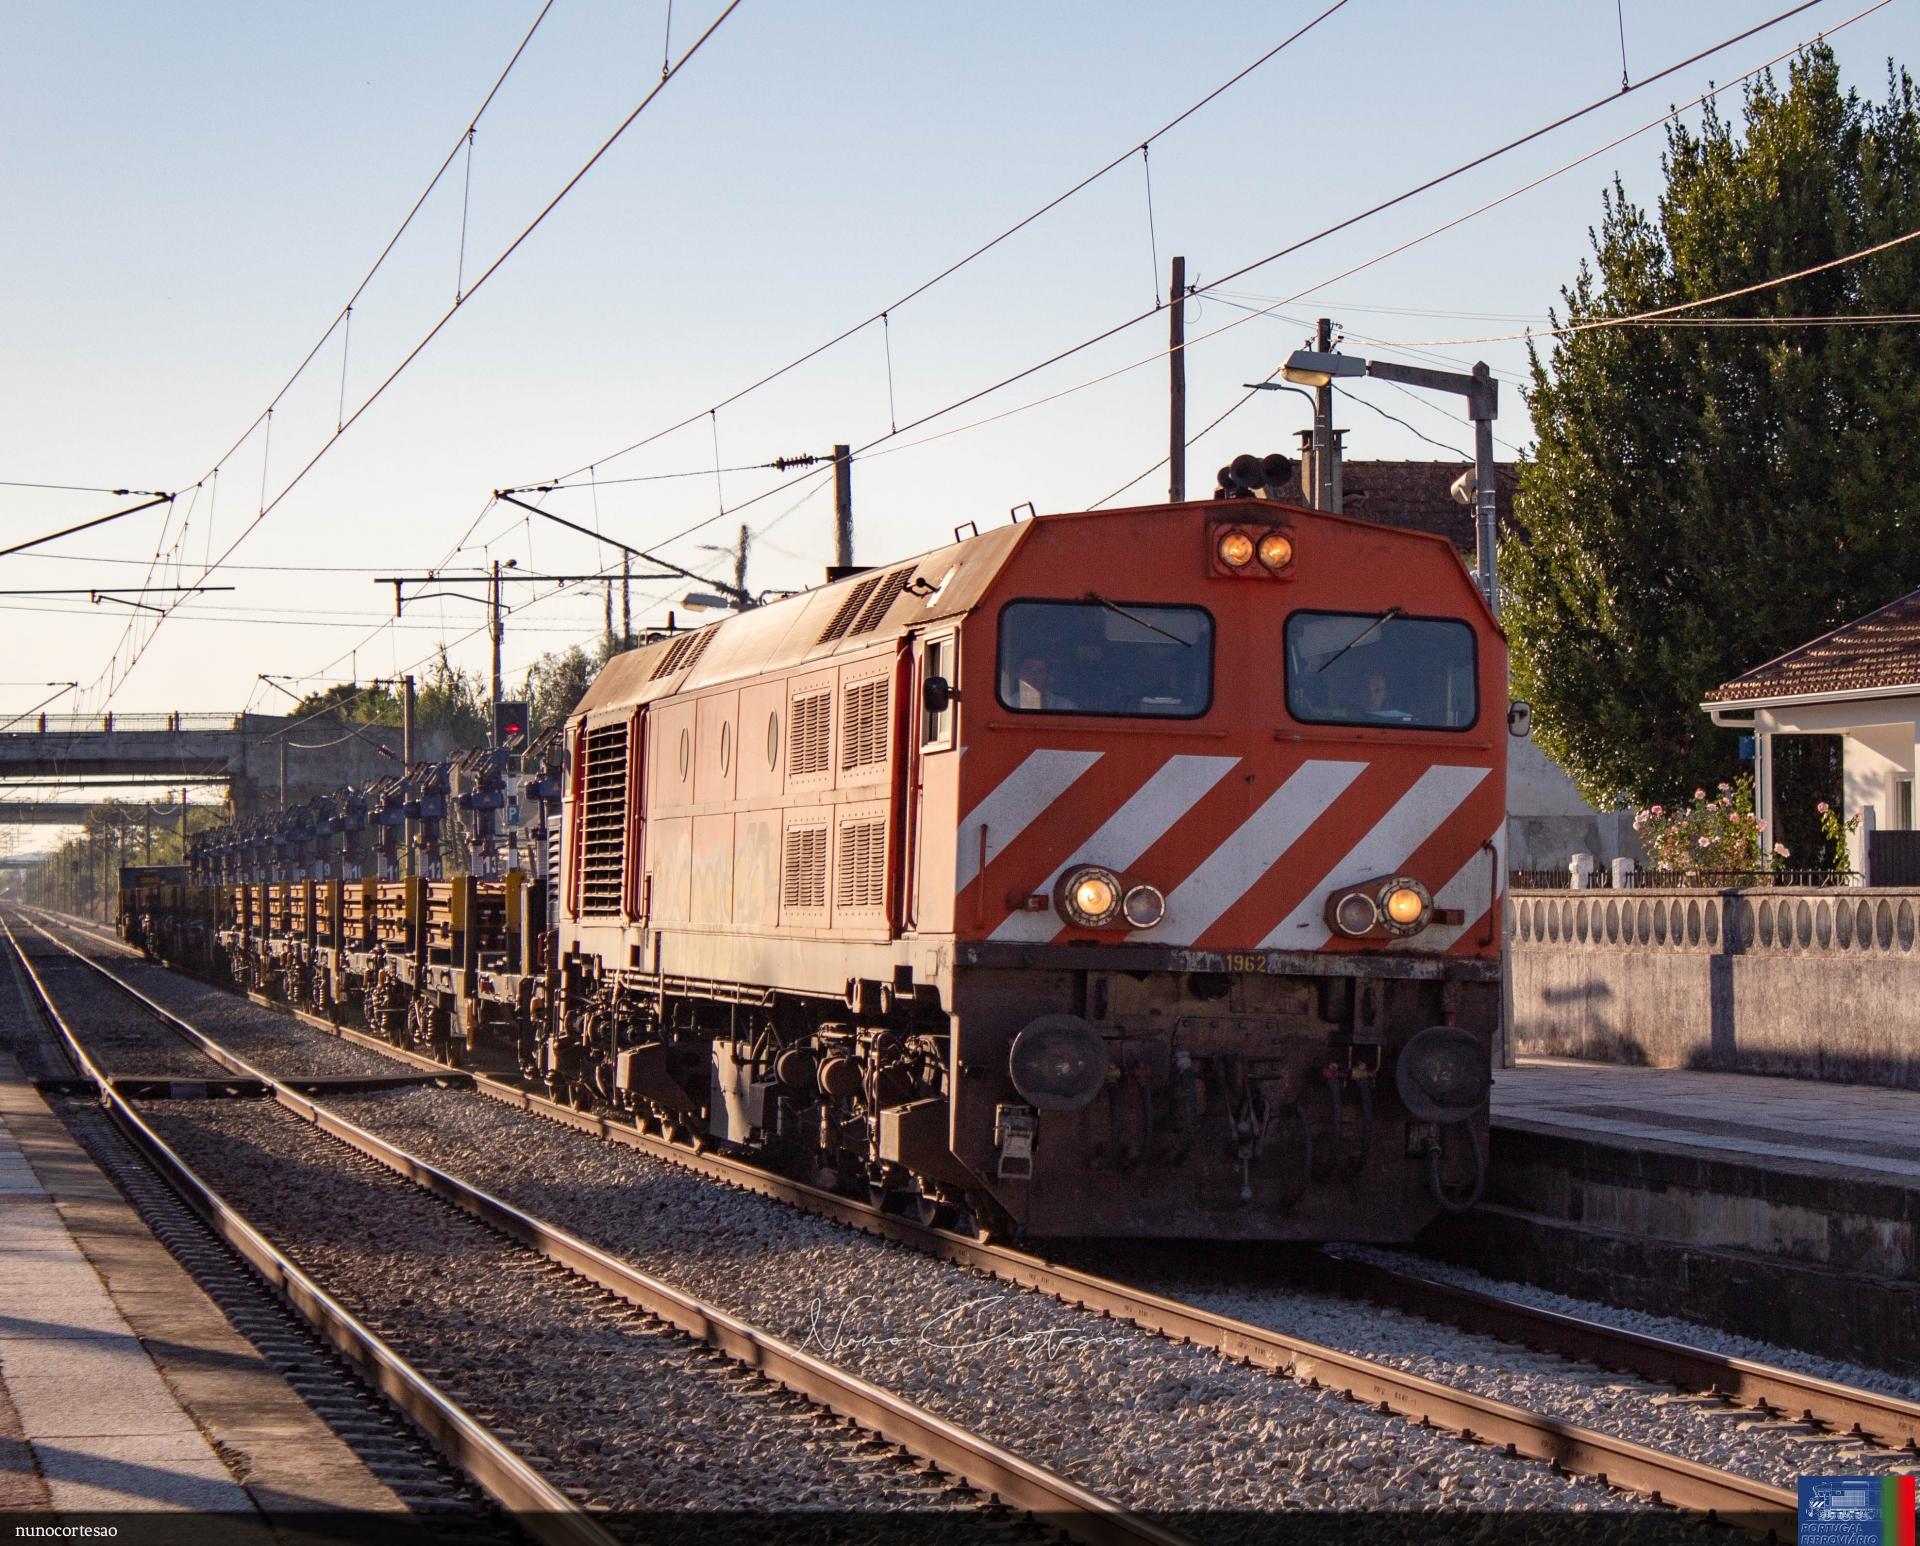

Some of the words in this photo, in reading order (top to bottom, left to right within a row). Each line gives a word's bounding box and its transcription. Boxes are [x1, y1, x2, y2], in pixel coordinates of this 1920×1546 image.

[509, 807, 517, 821] P
[323, 863, 331, 876] 9
[483, 856, 497, 873] 13
[1226, 953, 1266, 972] 1962
